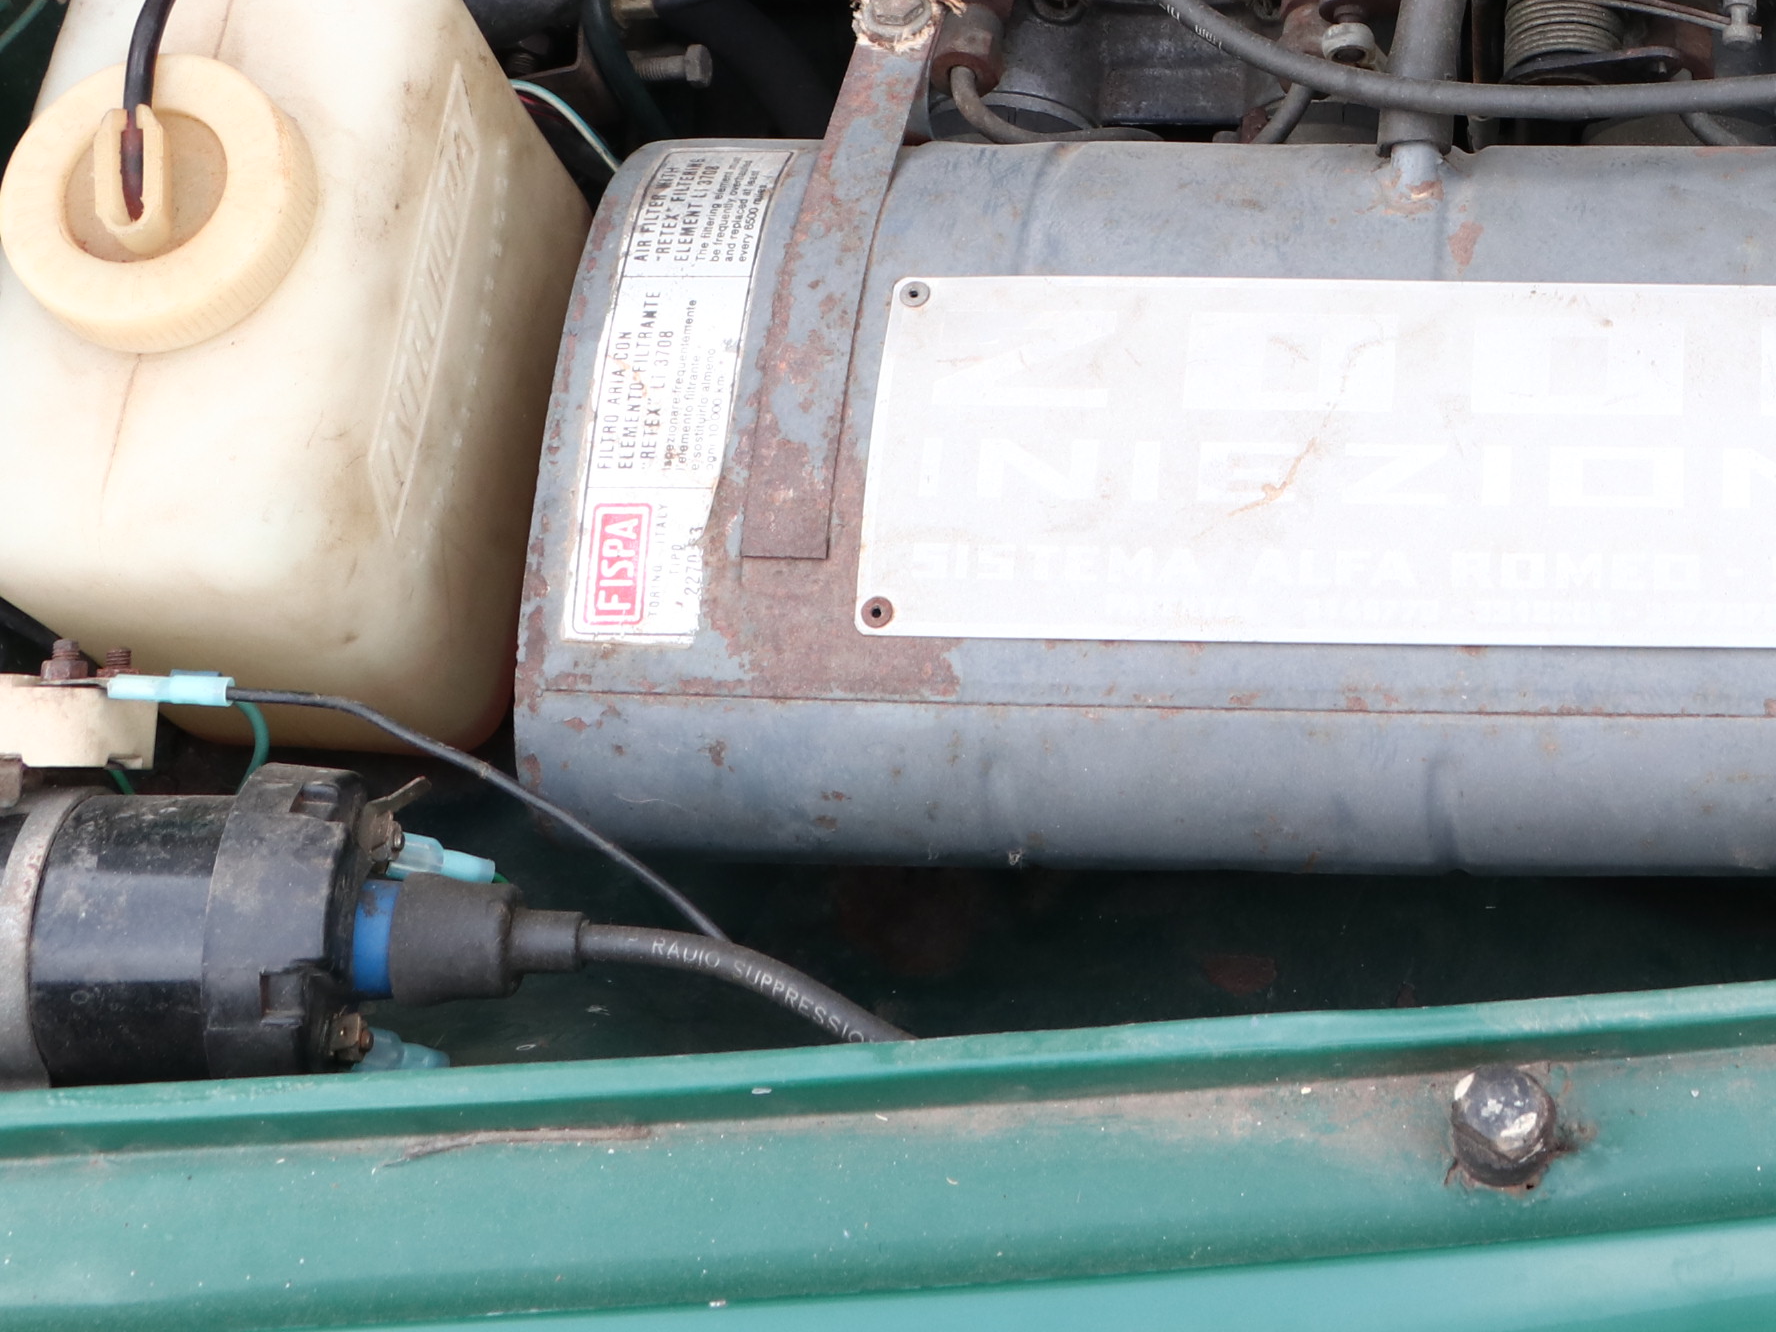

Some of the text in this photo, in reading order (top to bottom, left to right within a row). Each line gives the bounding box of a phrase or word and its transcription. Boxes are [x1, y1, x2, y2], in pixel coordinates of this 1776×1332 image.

[714, 170, 735, 201] element
[742, 186, 754, 197] at
[634, 167, 681, 262] AIR FILTER WITH
[673, 202, 703, 262] ELEMENT
[696, 165, 721, 186] 3708
[700, 202, 723, 239] filtering
[712, 197, 738, 246] frequently
[729, 197, 750, 240] replaced
[743, 206, 760, 231] 6500
[695, 241, 710, 262] The
[709, 248, 722, 262] be
[724, 242, 737, 263] and
[738, 233, 754, 263] every
[652, 330, 675, 367] 3708
[671, 299, 698, 395] frequentemente
[701, 347, 717, 393] almeno
[597, 331, 633, 470] FILTRO ARIA CON
[617, 290, 662, 470] ELEMENTO FILTRANTE
[682, 354, 702, 401] filtrante
[596, 517, 640, 611] FISPA
[647, 504, 669, 617] TORINO ITALY
[911, 541, 1202, 592] SISTEMA
[1247, 546, 1420, 591] ALFA
[1450, 549, 1702, 595] ROMEO
[650, 936, 880, 1044] RADIO SUPPRESSIO
